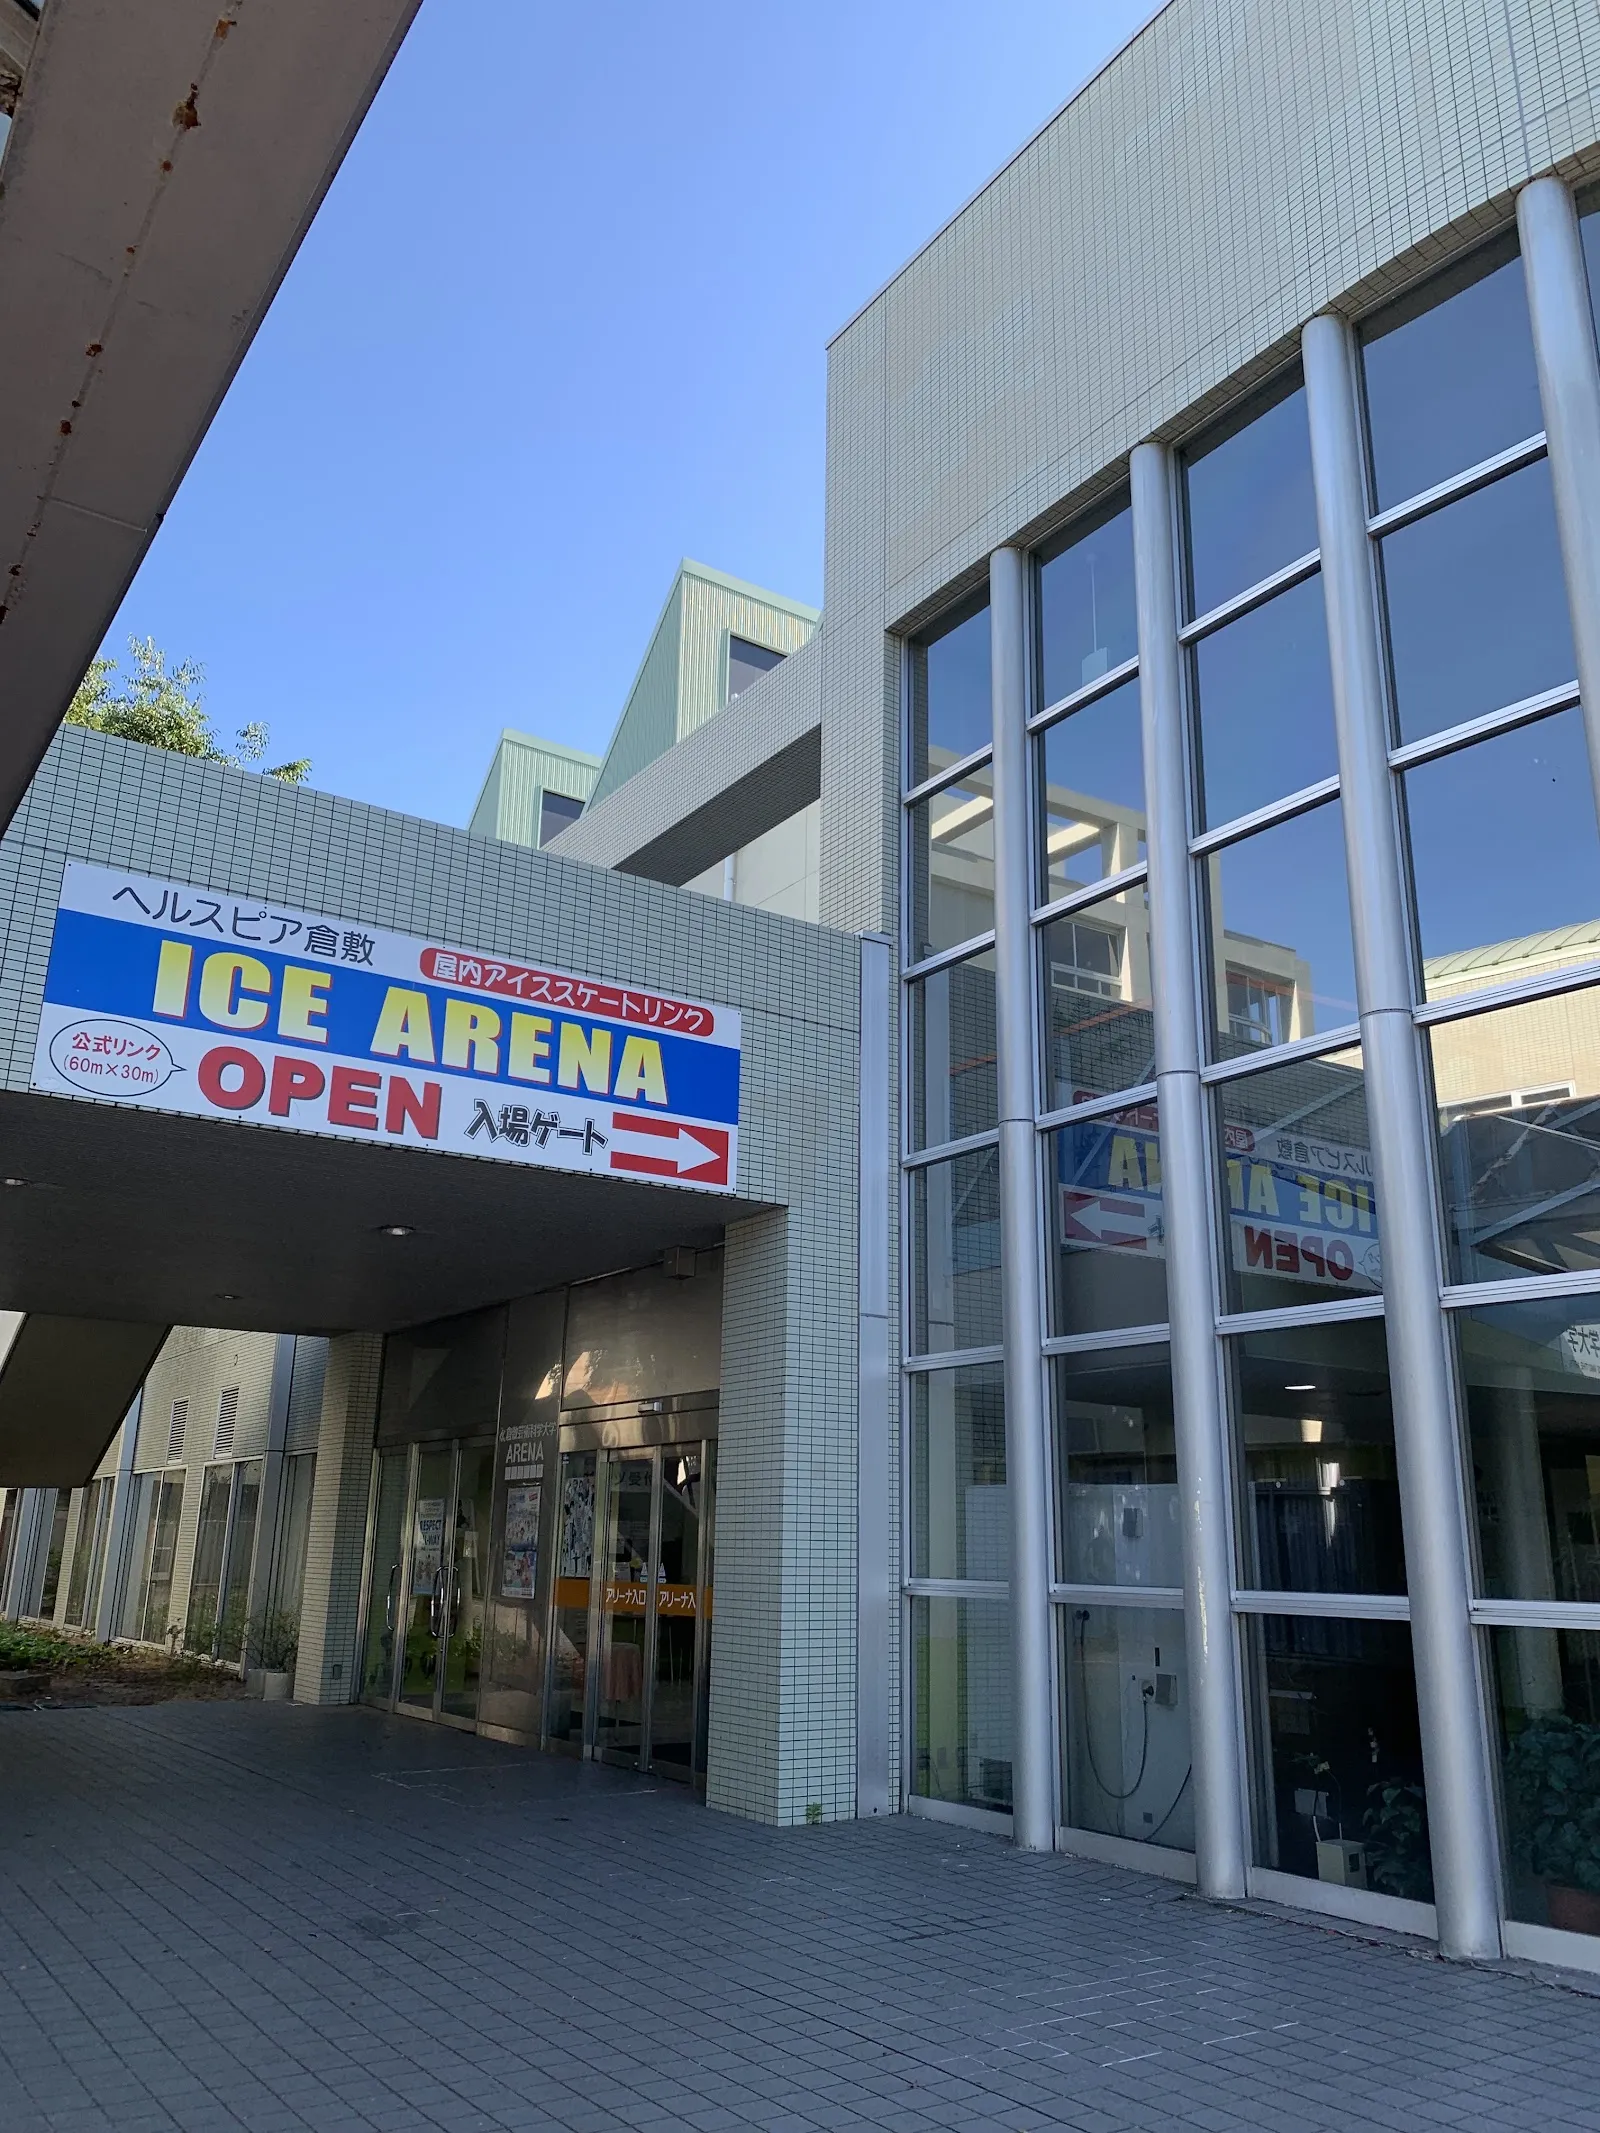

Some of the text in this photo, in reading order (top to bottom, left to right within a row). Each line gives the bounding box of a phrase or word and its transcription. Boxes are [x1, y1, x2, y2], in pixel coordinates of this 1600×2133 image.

[112, 885, 375, 967] ヘルスピア倉敷
[152, 939, 669, 1106] ICE ARENA
[432, 951, 704, 1032] 屋内アイススケートリンク
[72, 1031, 161, 1062] 公式リンク
[197, 1045, 443, 1141] OPEN
[464, 1098, 608, 1156] 入場ゲート
[505, 1440, 544, 1464] ARENA
[606, 1588, 646, 1605] アリーナ入口
